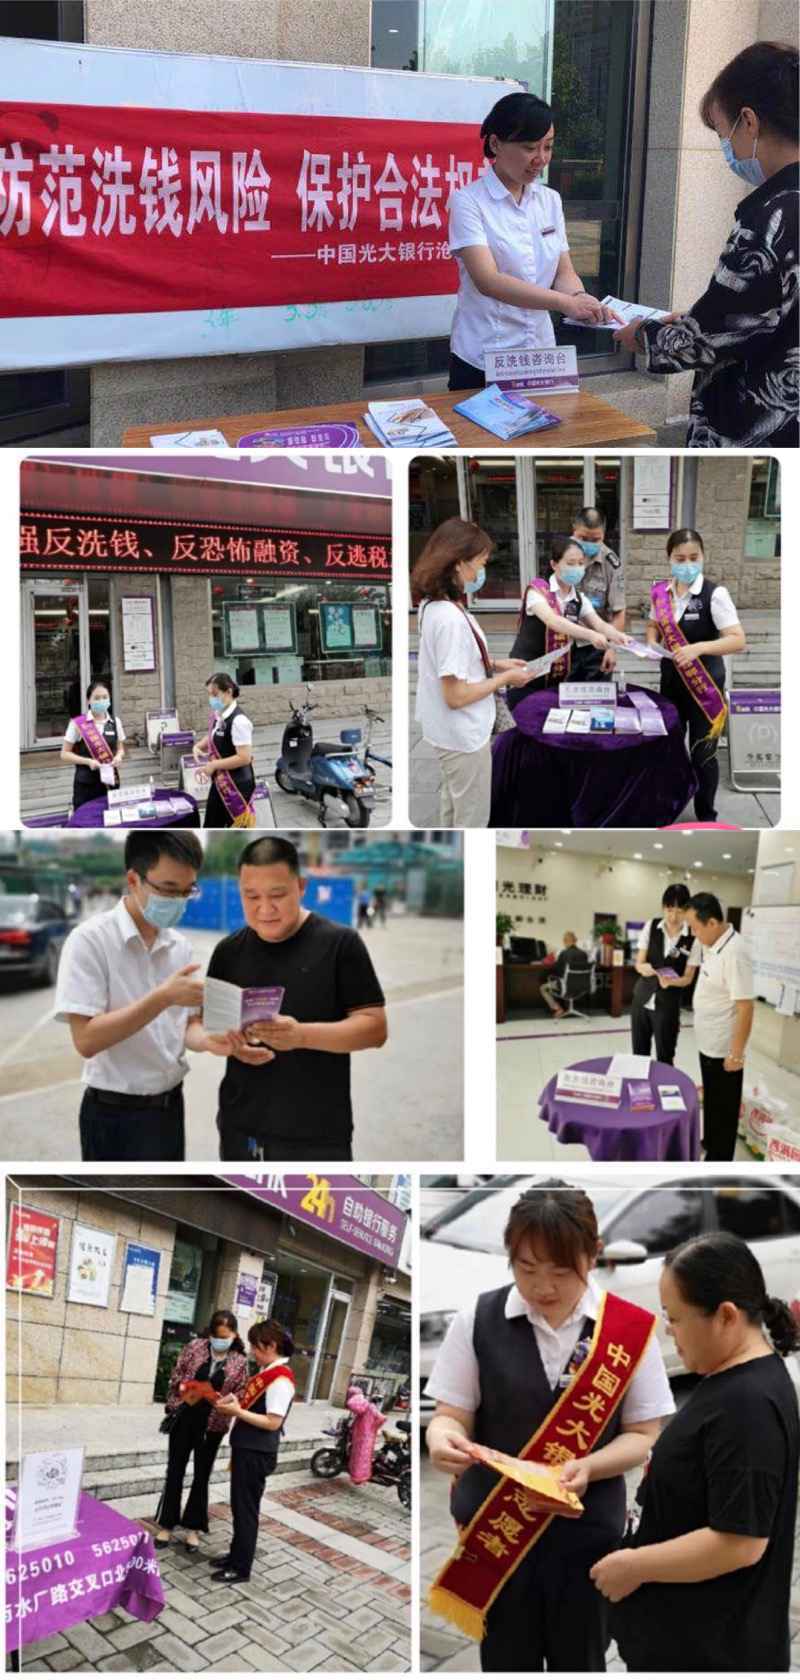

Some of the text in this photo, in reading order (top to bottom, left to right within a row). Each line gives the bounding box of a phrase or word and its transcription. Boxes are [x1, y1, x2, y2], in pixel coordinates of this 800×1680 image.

[0, 141, 271, 238] 防范洗钱风险
[496, 880, 547, 896] 光理财
[343, 1197, 398, 1243] 自助银行服务
[6, 1550, 75, 1585] 625010
